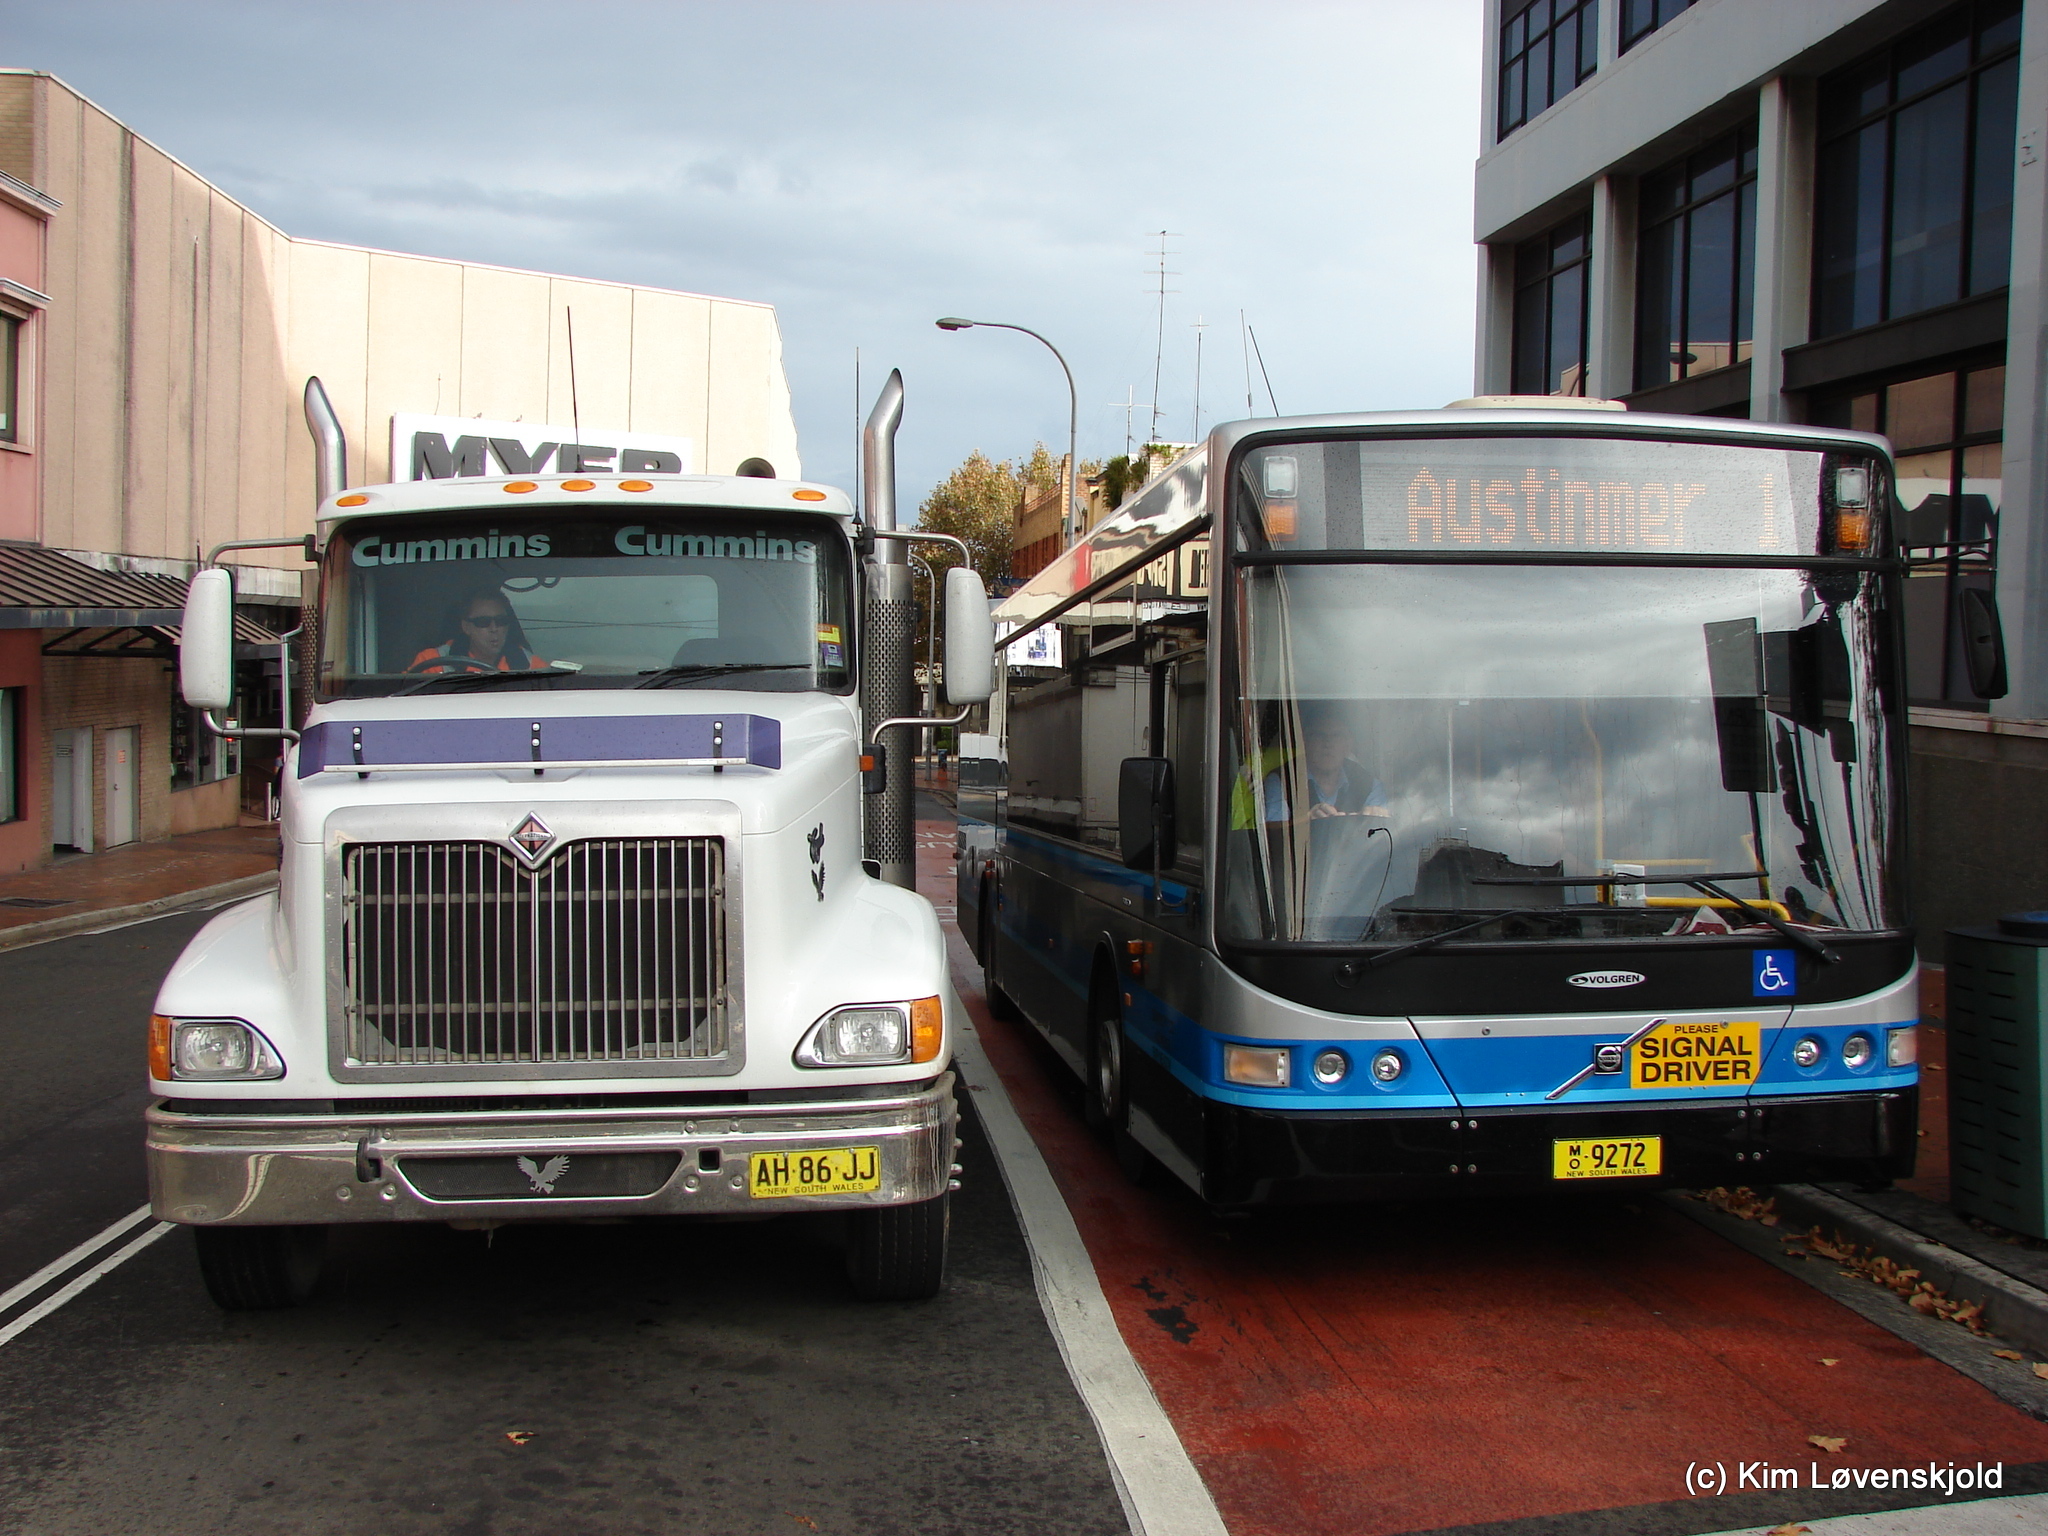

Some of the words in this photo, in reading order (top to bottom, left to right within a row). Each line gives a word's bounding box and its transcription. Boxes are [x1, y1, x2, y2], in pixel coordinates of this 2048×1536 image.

[1407, 466, 1706, 546] Austinmer
[1758, 473, 1780, 547] 1
[352, 529, 551, 568] Cummins
[614, 525, 818, 564] Cummins
[1588, 974, 1641, 984] VOLGREN
[1674, 1024, 1719, 1034] PLEASE
[1639, 1036, 1752, 1059] SIGNAL
[1641, 1060, 1752, 1083] DRIVER
[1588, 1169, 1617, 1177] SOUTH
[1621, 1167, 1648, 1175] WALES
[767, 1186, 788, 1195] NEW
[832, 1183, 864, 1191] WALES
